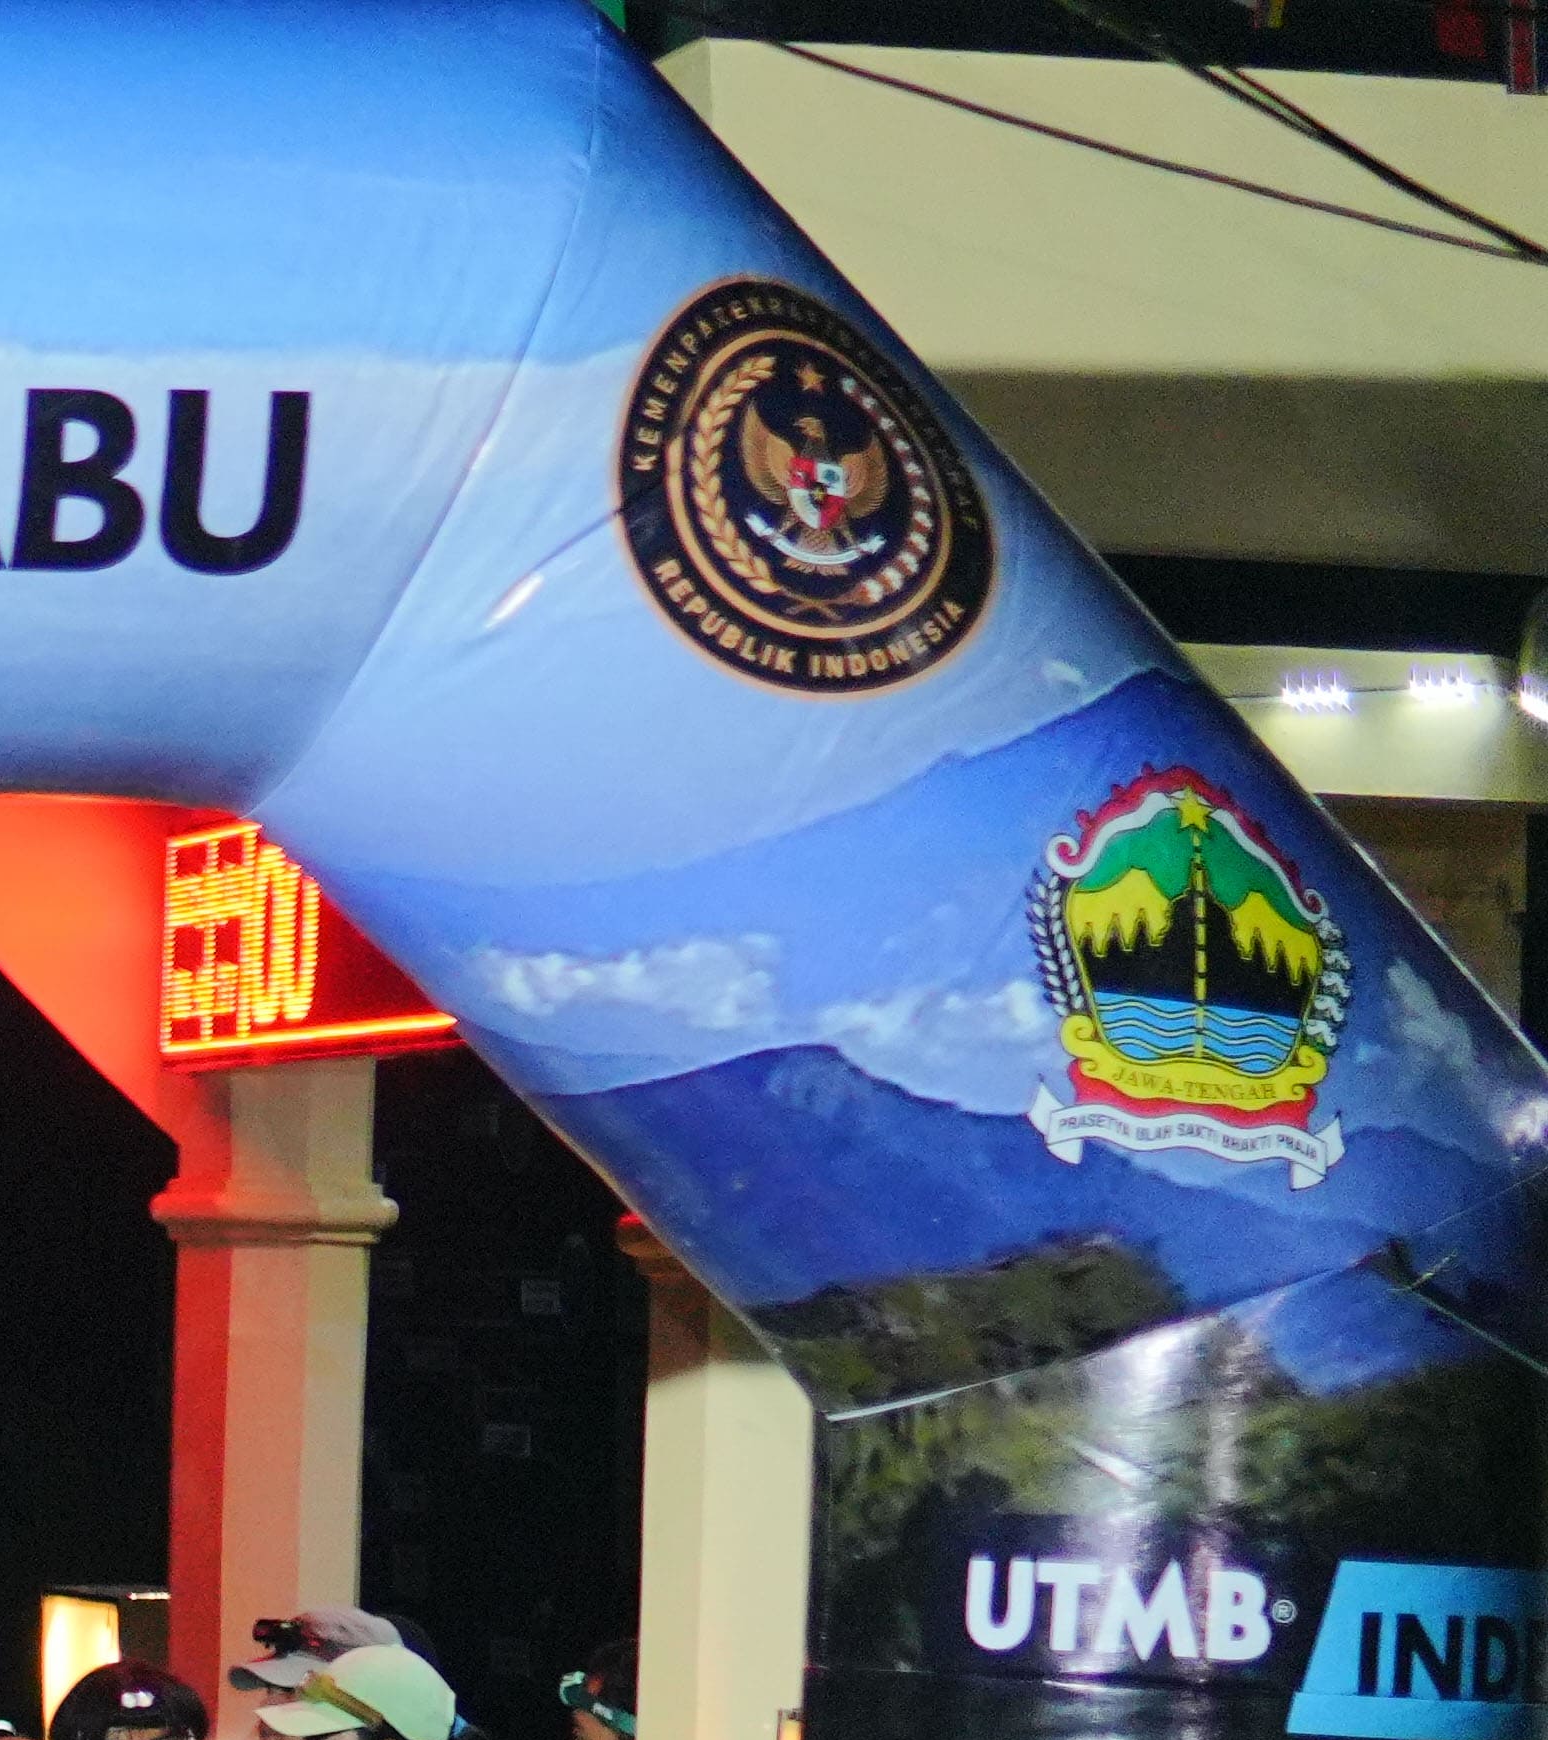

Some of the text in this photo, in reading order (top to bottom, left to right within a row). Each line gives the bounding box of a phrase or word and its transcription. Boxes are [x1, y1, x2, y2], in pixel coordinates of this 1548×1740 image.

[656, 556, 965, 678] REPUBLIK INDONESIA
[1111, 1066, 1277, 1100] JAWA-TENGAH
